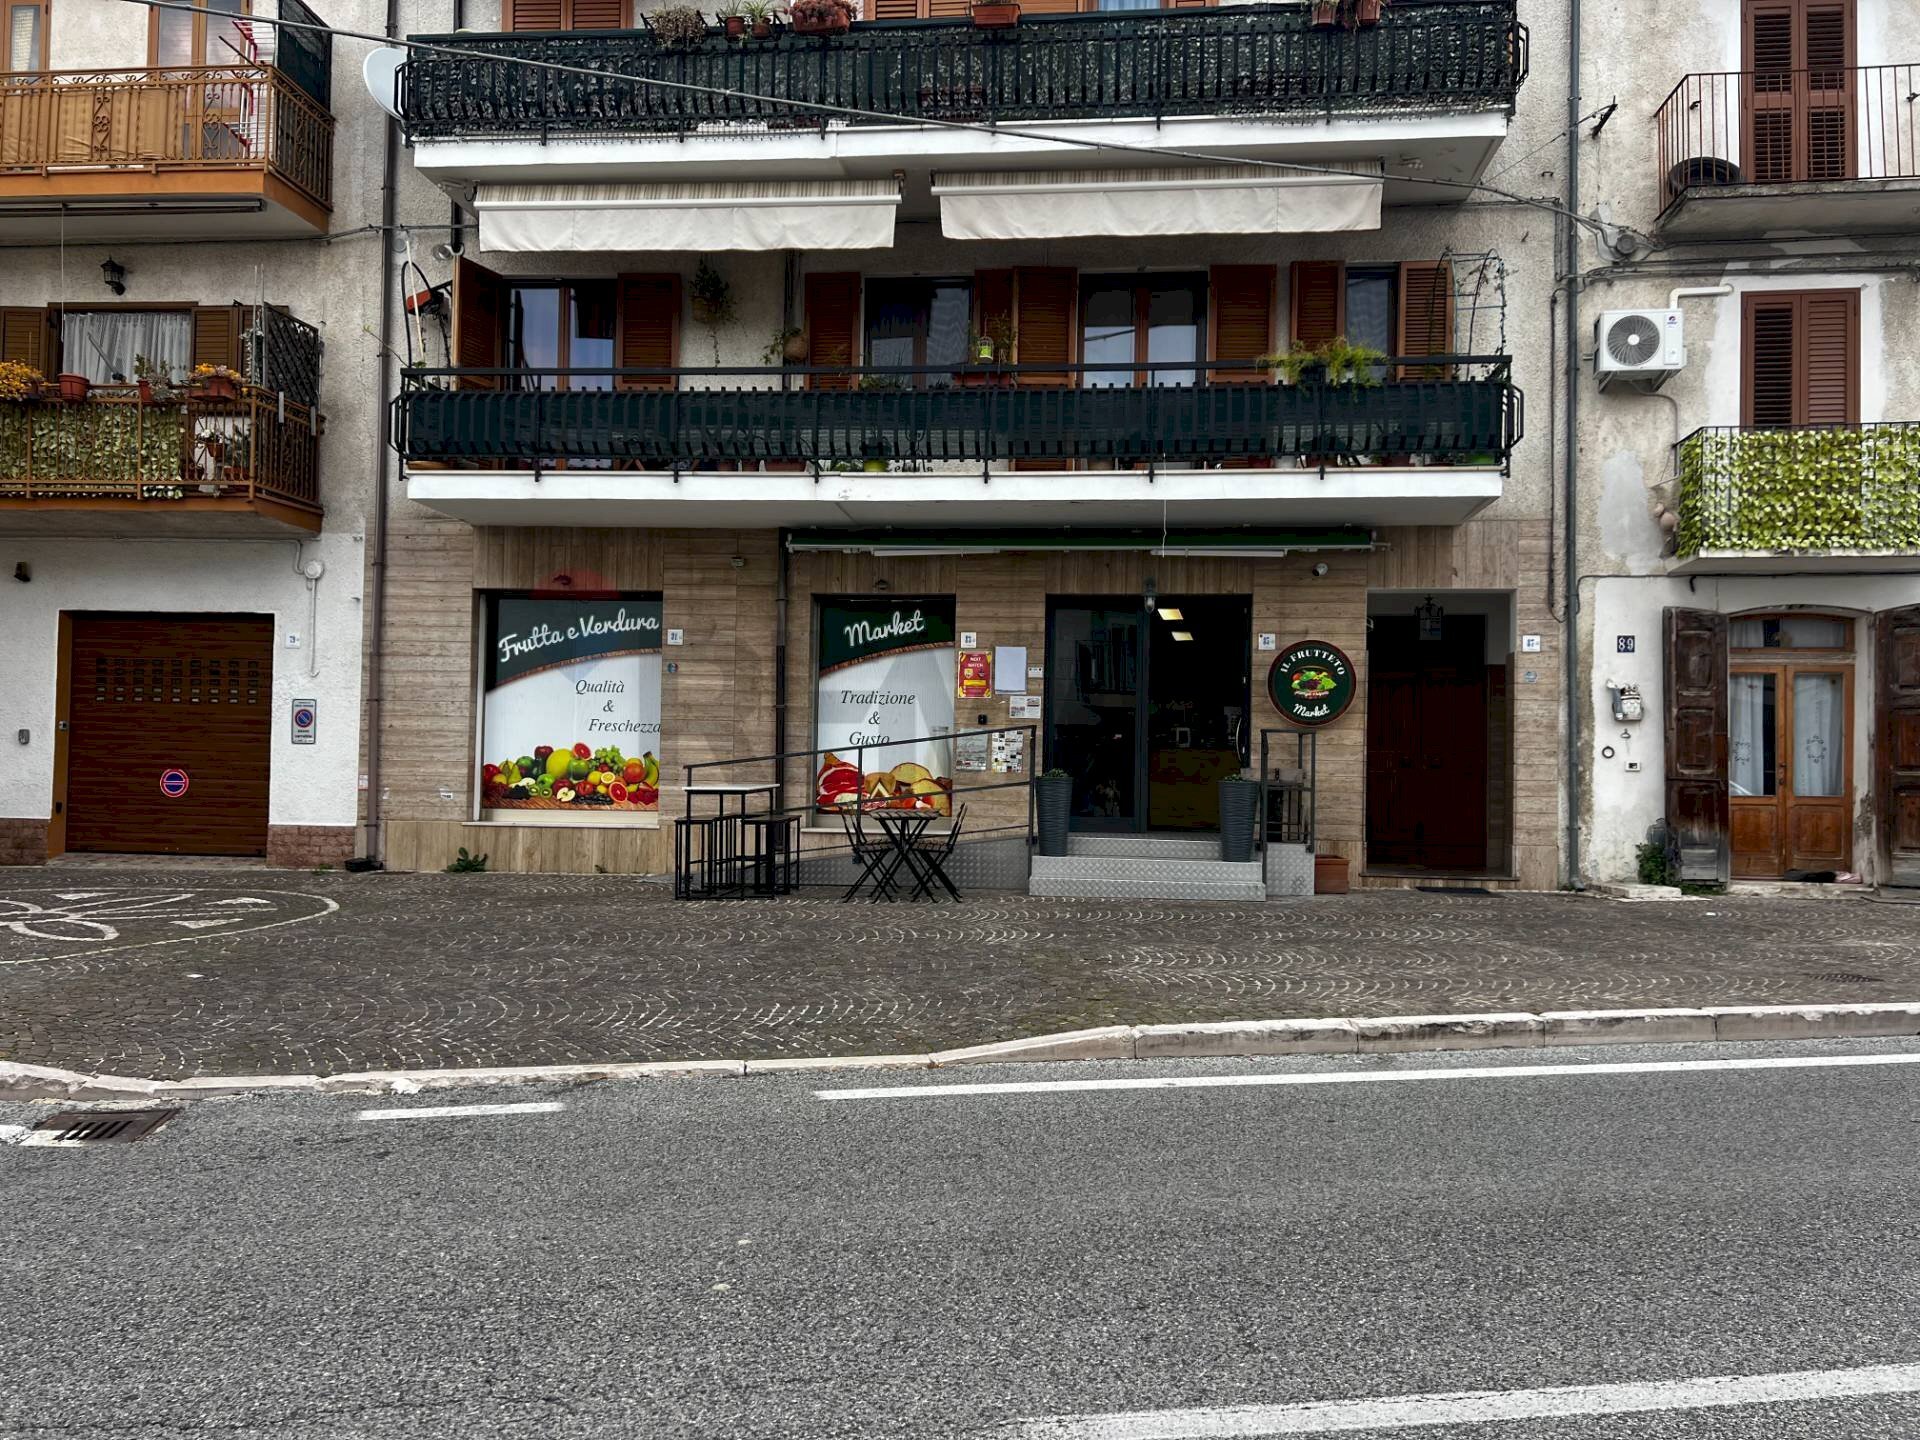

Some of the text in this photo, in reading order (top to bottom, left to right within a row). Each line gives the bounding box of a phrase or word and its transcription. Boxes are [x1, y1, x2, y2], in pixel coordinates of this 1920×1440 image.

[499, 608, 660, 663] Frutta e Verdura
[844, 609, 925, 647] Market
[1617, 637, 1635, 651] 89
[1280, 649, 1345, 675] IL FRUTTETO
[575, 679, 625, 695] Qualità
[602, 699, 615, 712] &
[841, 690, 916, 706] Tradizione
[868, 711, 881, 724] &
[1292, 703, 1331, 717] Market
[588, 718, 661, 733] Freschezza
[849, 731, 891, 746] Gusto
